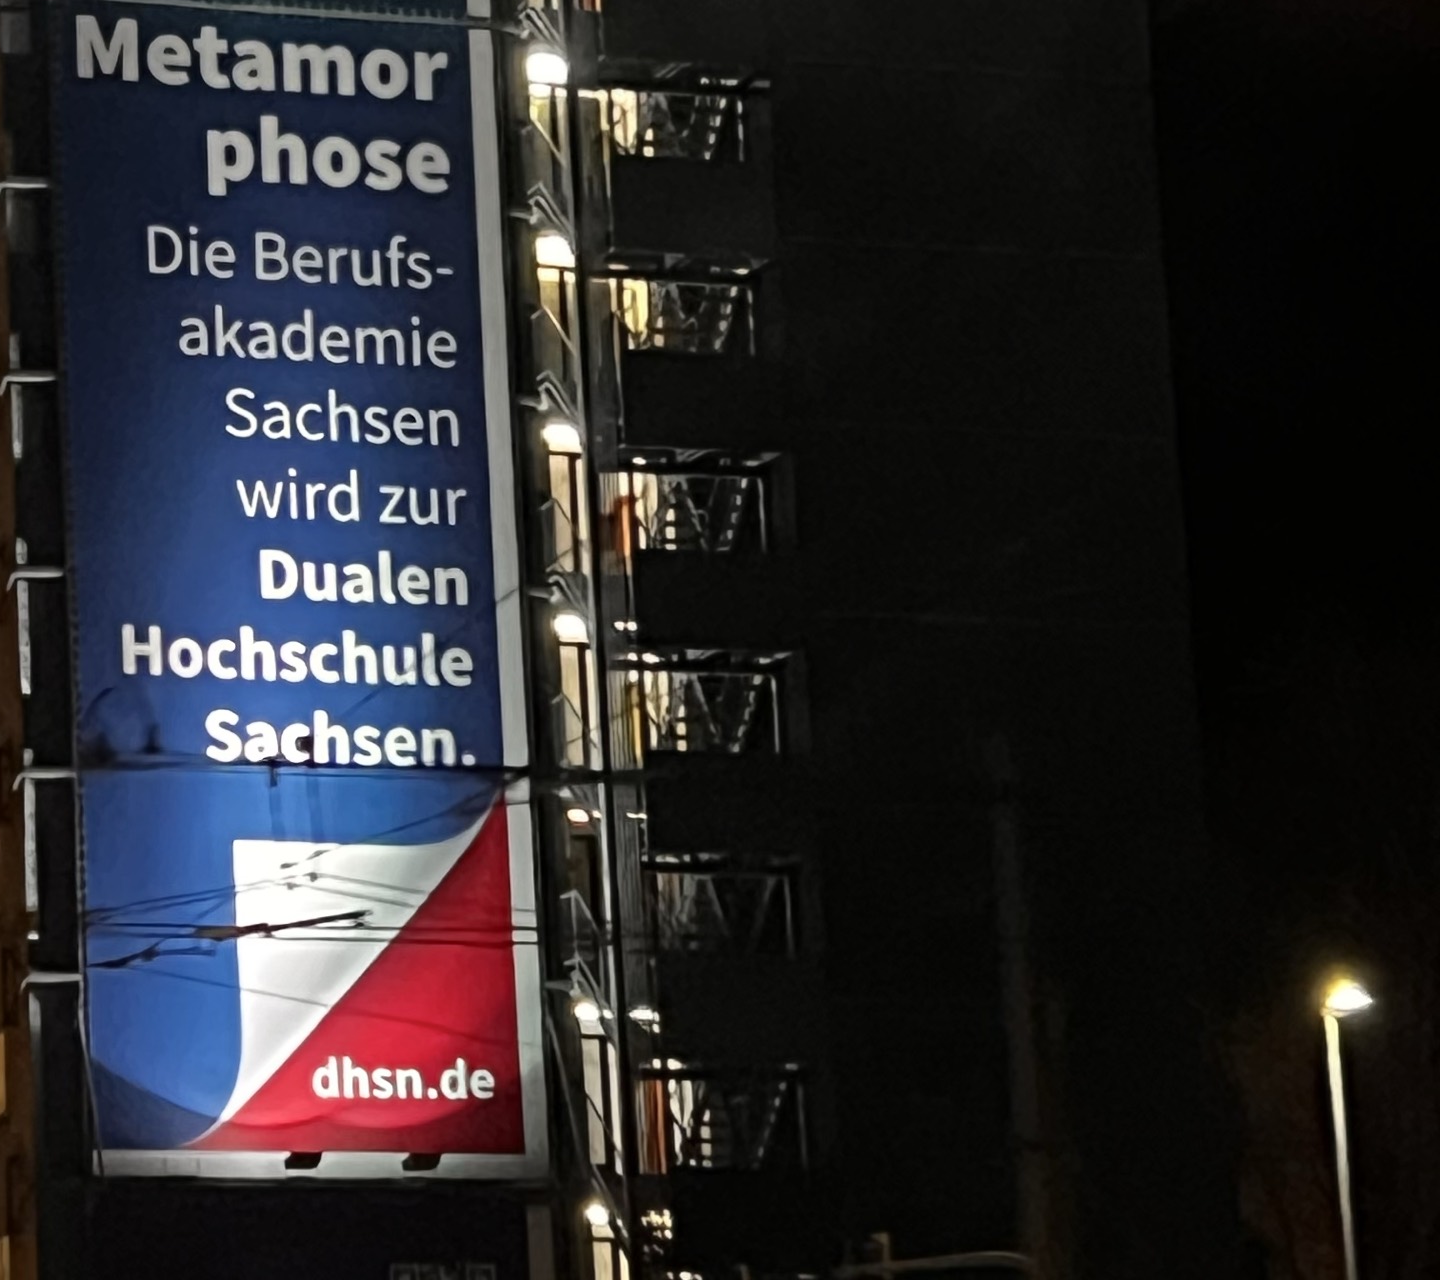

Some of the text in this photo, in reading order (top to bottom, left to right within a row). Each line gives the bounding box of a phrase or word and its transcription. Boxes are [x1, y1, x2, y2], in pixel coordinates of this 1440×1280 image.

[75, 14, 449, 101] Metamor
[206, 115, 451, 197] phose
[147, 224, 454, 289] Die Berufs-
[178, 304, 458, 368] akademie
[225, 387, 460, 447] Sachsen
[236, 467, 467, 526] wird zur
[259, 549, 469, 606] Dualen
[121, 623, 474, 687] Hochschule
[205, 708, 476, 767] Sachsen.
[311, 1056, 496, 1101] dhsn.de
